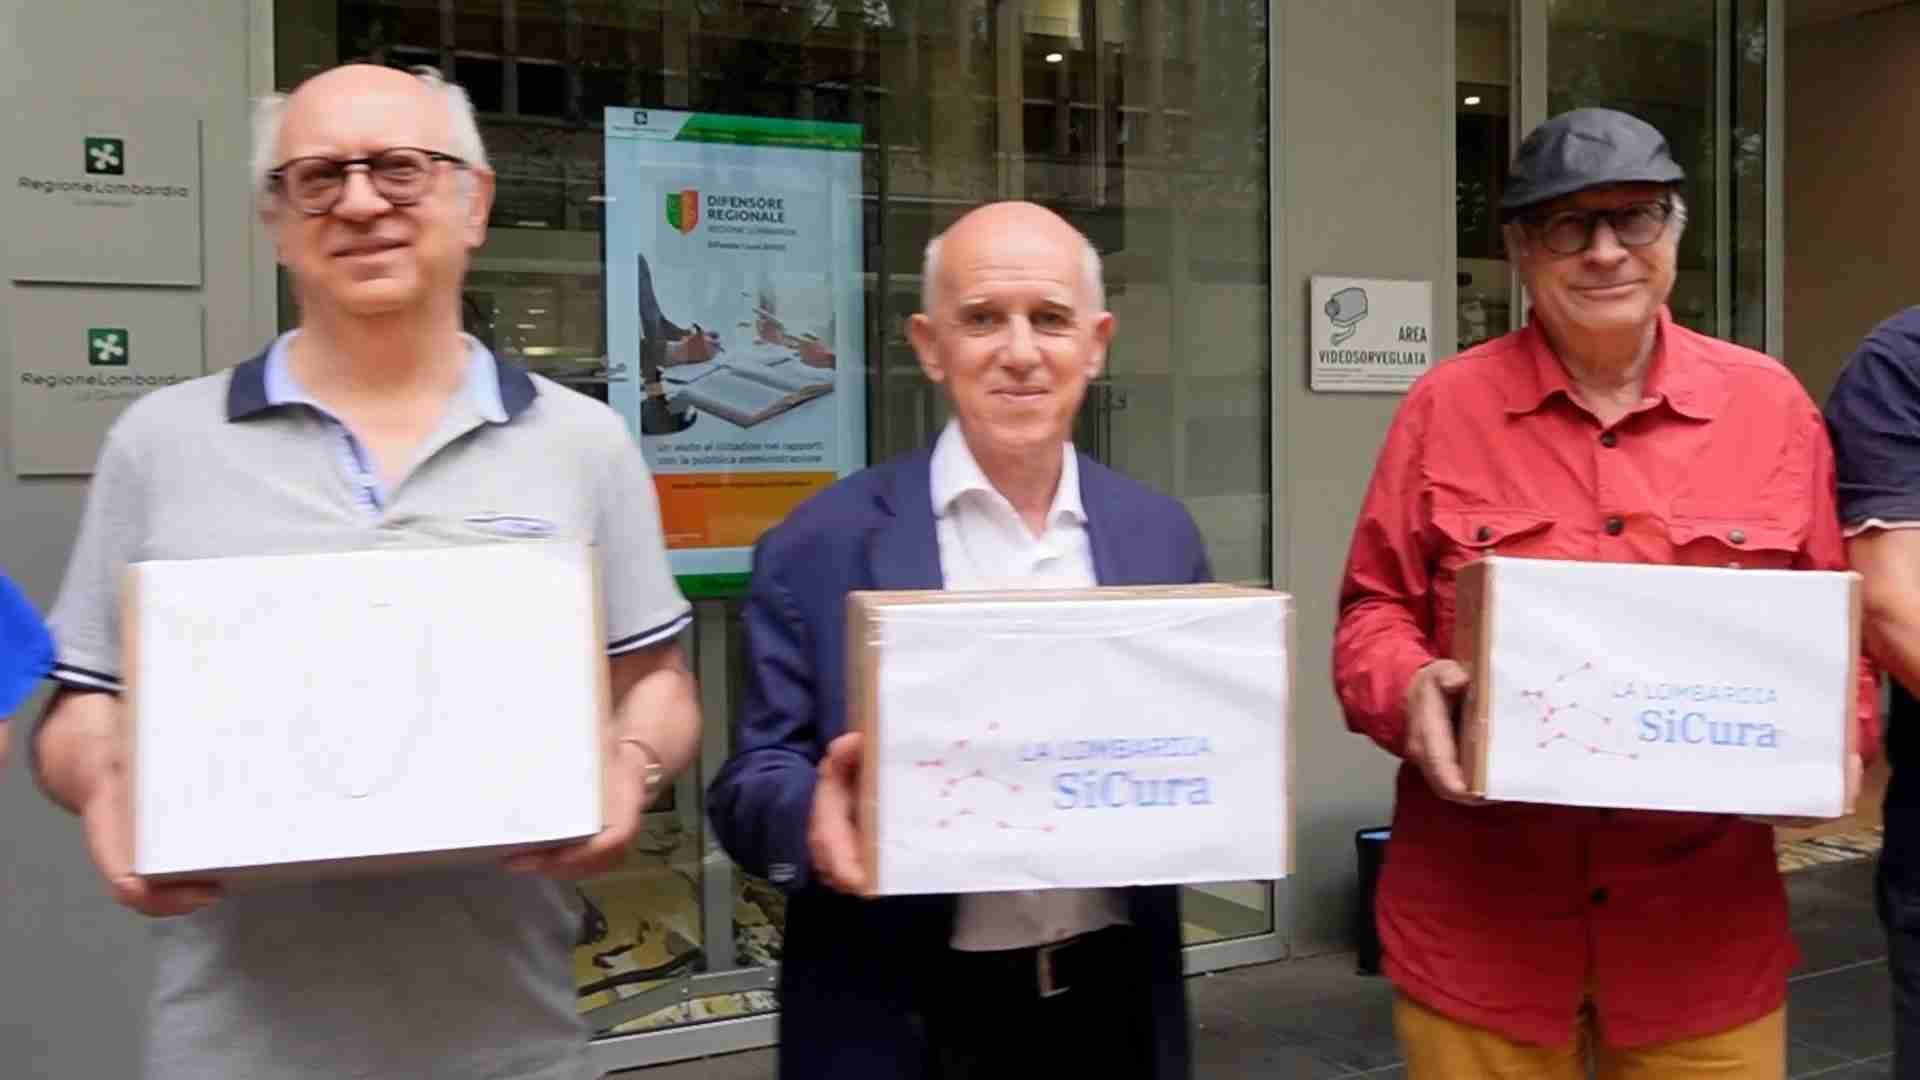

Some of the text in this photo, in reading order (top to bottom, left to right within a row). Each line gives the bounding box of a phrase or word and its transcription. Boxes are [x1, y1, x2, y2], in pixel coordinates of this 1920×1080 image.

[707, 194, 784, 210] DIFENSORE
[707, 208, 784, 224] REGIONALE
[1398, 325, 1428, 343] AREA
[1319, 350, 1427, 365] VIDEOSORVEGLIATA
[1638, 708, 1780, 749] SiCura
[1053, 767, 1214, 811] SiCura
